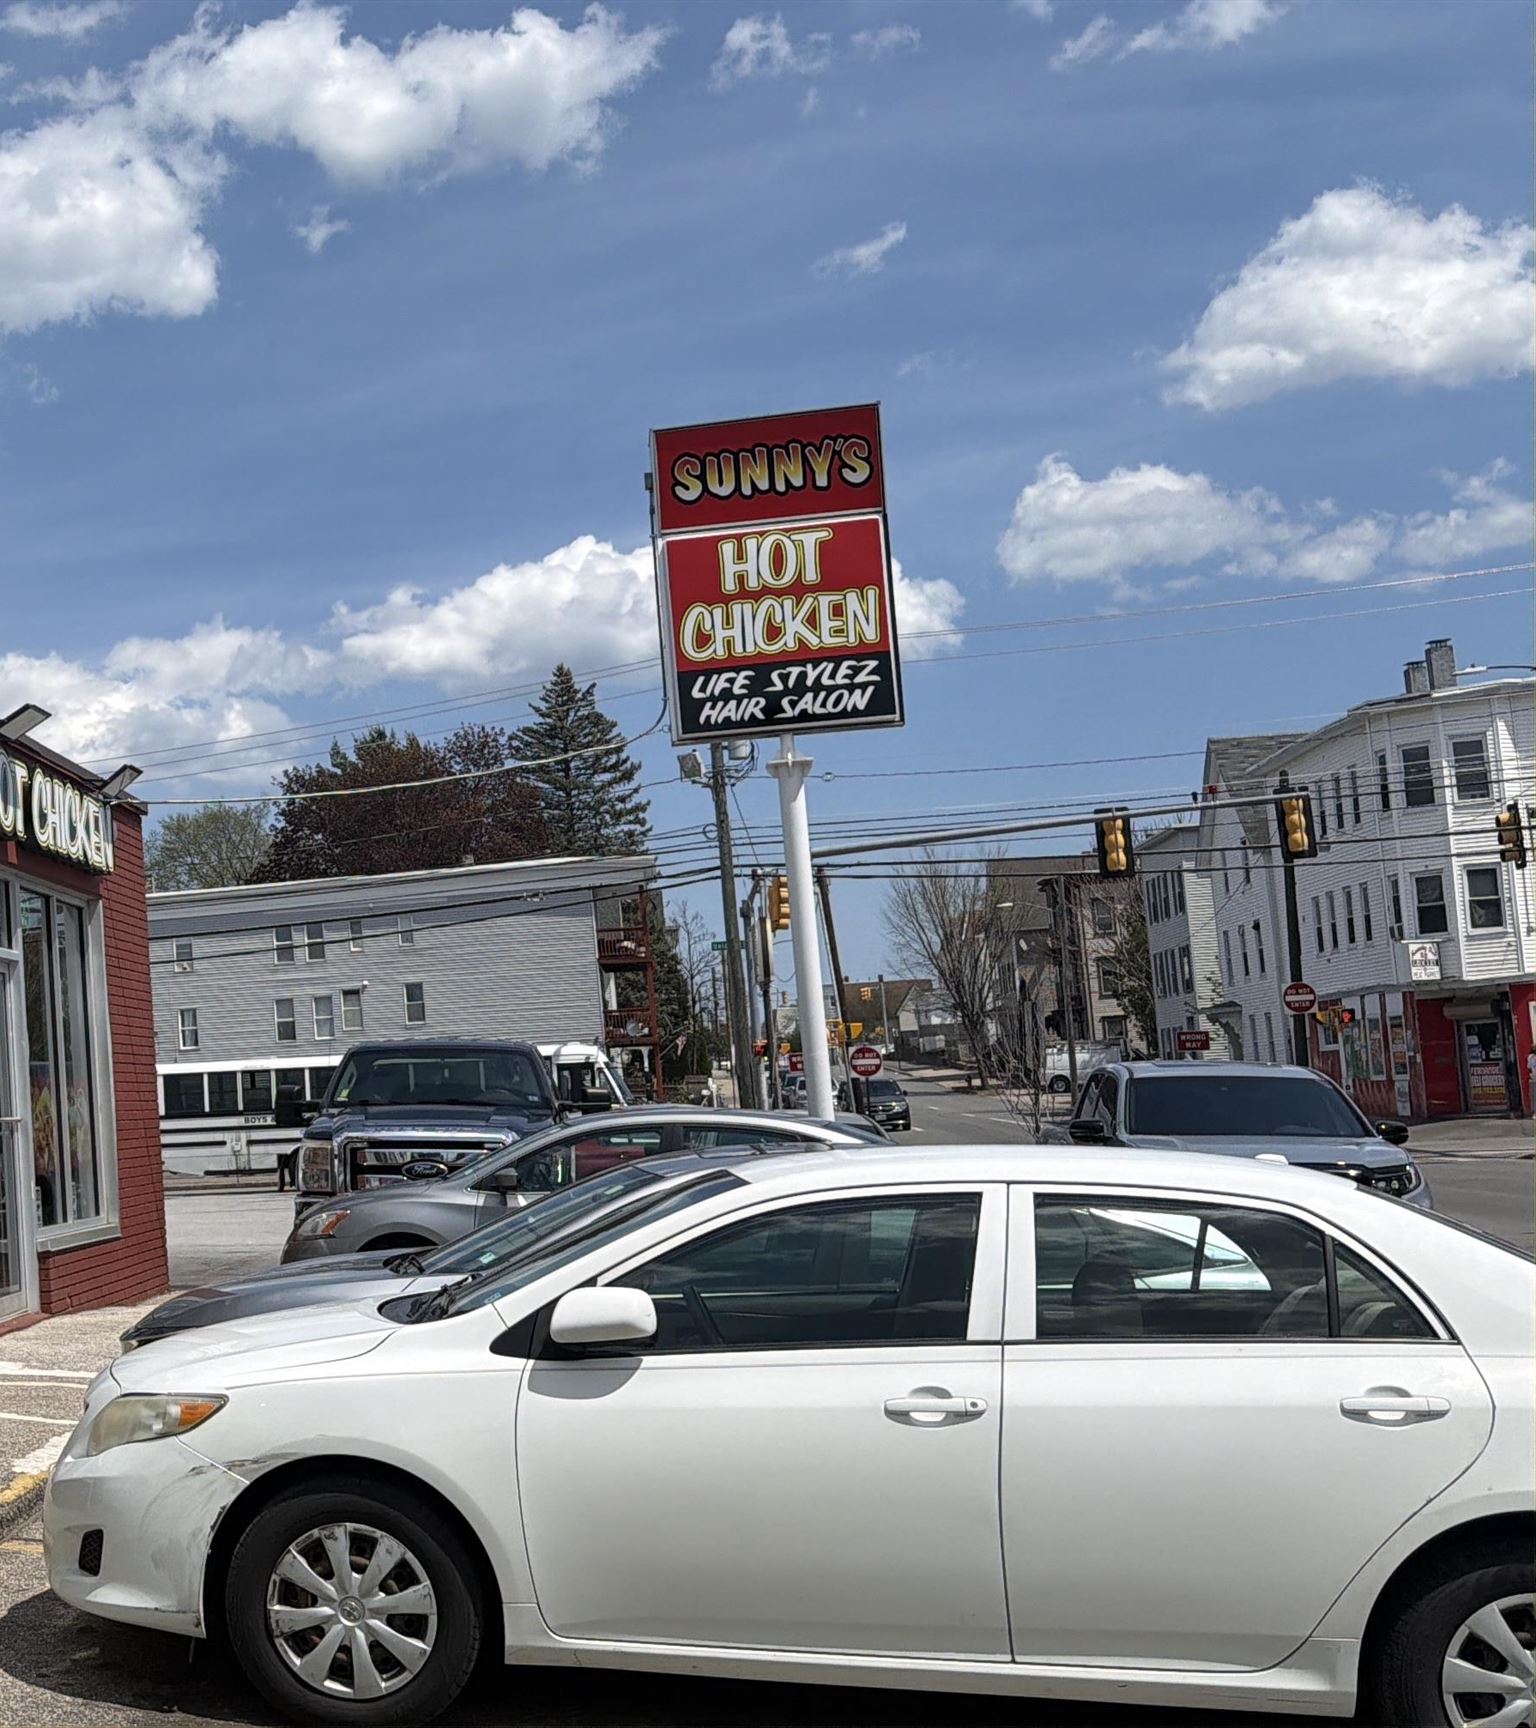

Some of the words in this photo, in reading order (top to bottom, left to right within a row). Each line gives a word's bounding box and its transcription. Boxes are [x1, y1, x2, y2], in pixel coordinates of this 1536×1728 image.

[673, 437, 871, 501] SUNNY'S
[718, 528, 834, 594] HOT
[680, 585, 880, 661] CHICKEN
[691, 670, 755, 699] LIFE
[763, 660, 882, 692] STYLEZ
[699, 697, 765, 726] HAIR
[774, 686, 876, 719] SALON
[31, 767, 115, 873] CHICKEN
[1180, 1033, 1207, 1041] WRONG
[244, 1116, 268, 1124] BOYS
[411, 1164, 438, 1176] Ford
